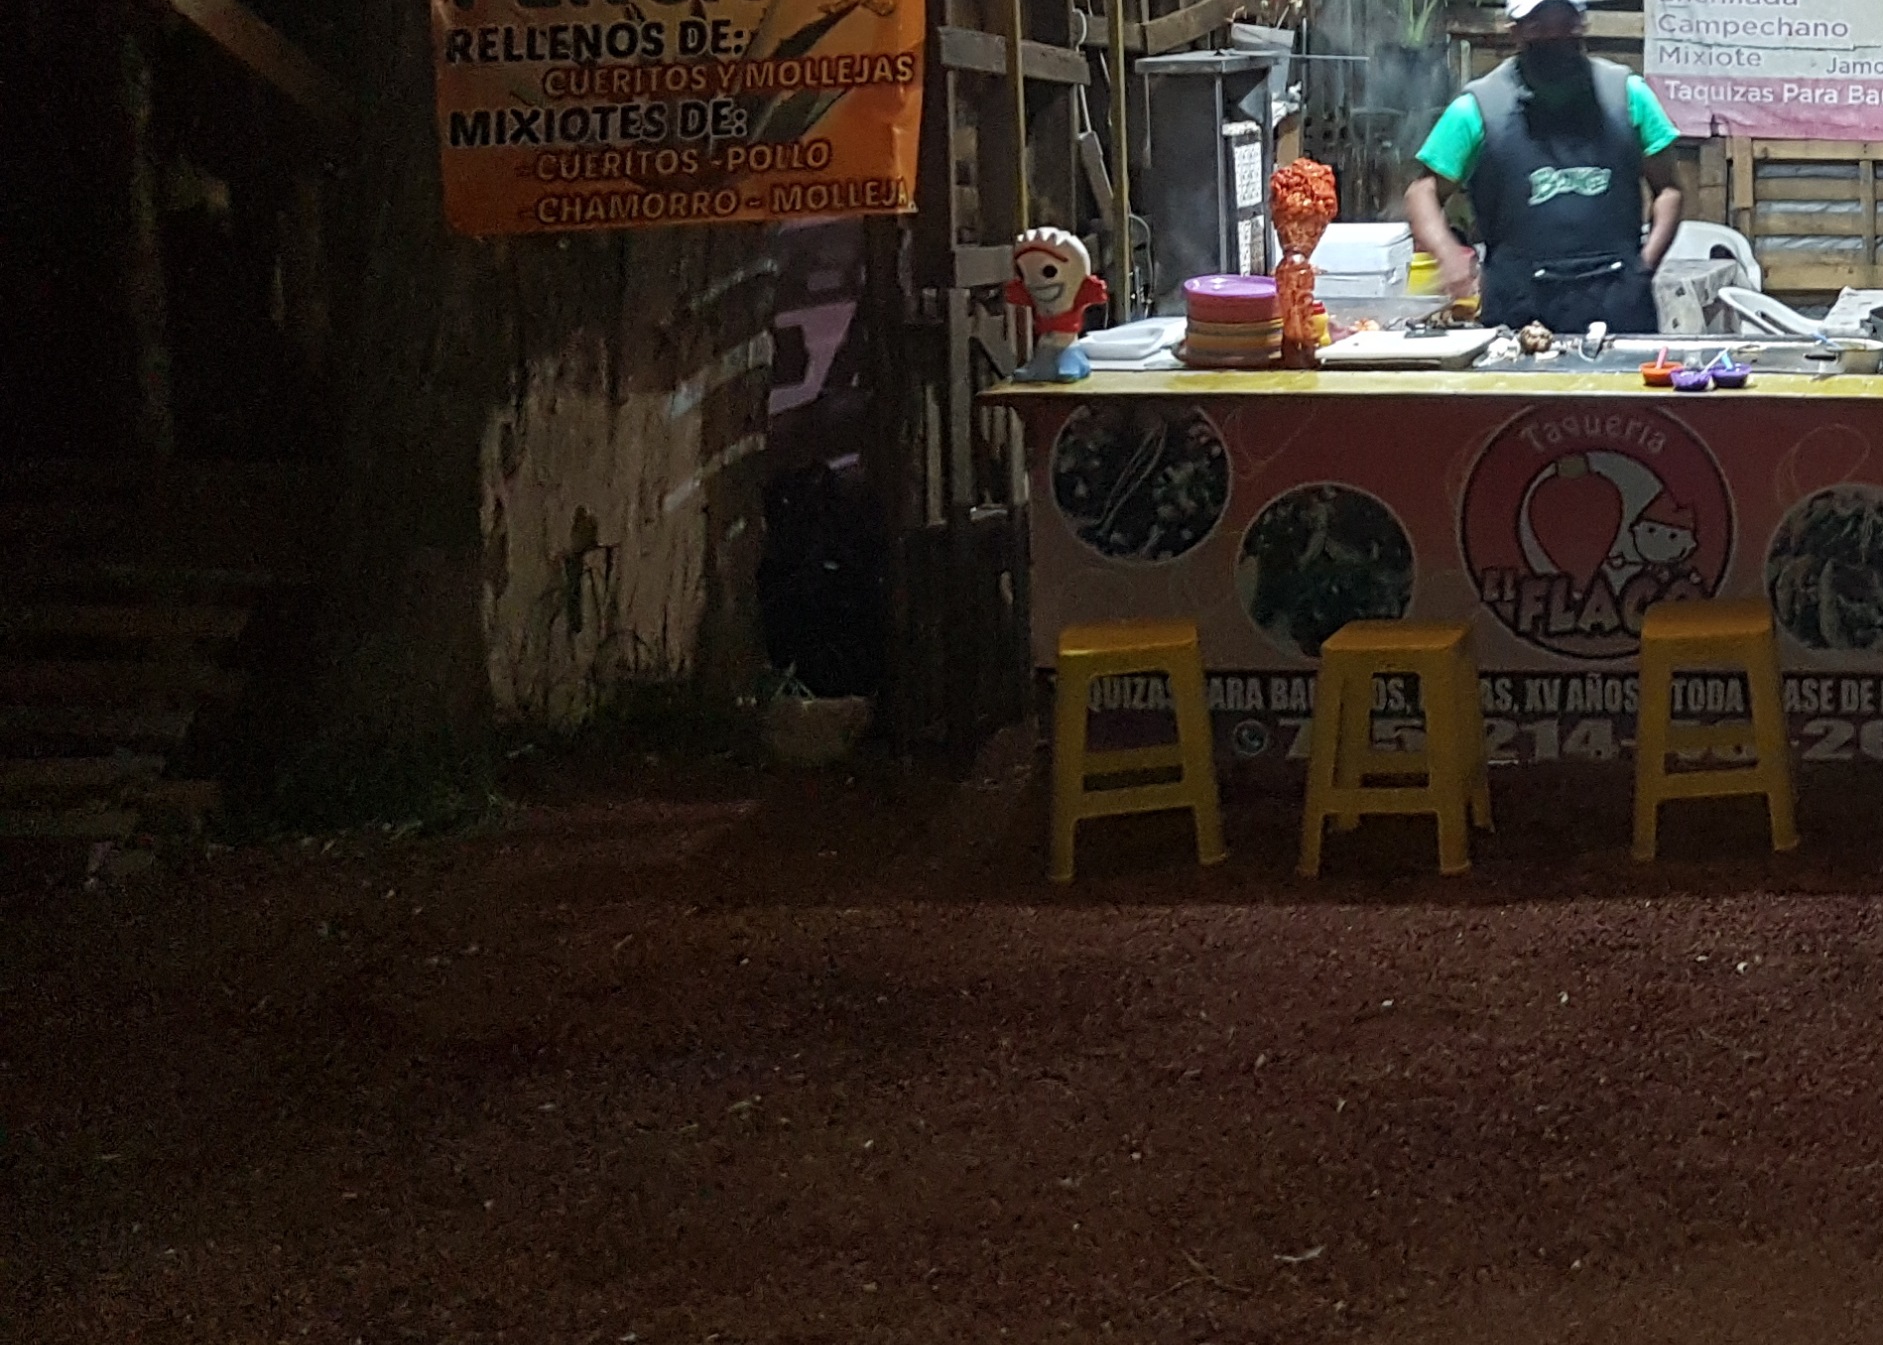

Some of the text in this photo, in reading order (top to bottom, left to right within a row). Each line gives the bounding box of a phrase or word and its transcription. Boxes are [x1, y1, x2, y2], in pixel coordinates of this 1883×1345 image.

[446, 18, 747, 64] RELLENOS DE:
[1658, 14, 1849, 39] Campechano
[1659, 46, 1762, 67] Mixiote
[544, 55, 915, 98] CUERITOS Y MOLLEJAS
[1666, 81, 1774, 104] Taquizas
[1783, 83, 1839, 105] Para
[449, 99, 748, 147] MIXIOTES DE:
[1519, 414, 1667, 454] Taqueria
[1523, 677, 1562, 712] XV
[1672, 677, 1745, 713] TODA
[1841, 679, 1875, 715] DE
